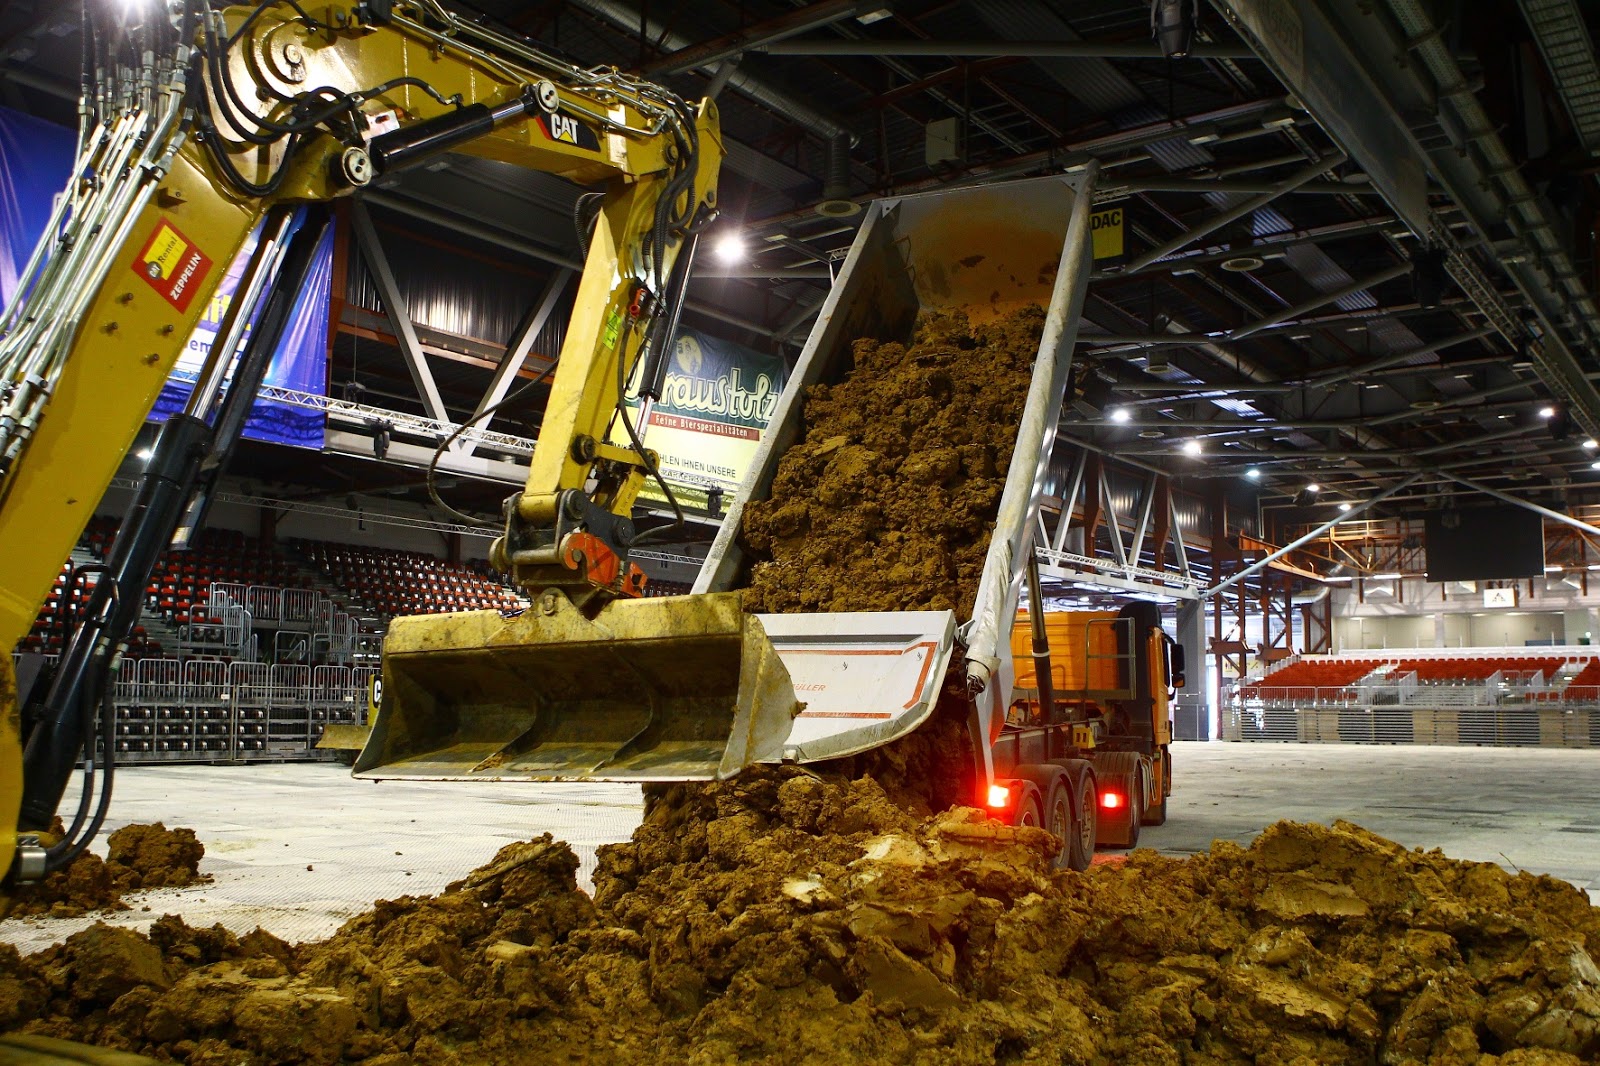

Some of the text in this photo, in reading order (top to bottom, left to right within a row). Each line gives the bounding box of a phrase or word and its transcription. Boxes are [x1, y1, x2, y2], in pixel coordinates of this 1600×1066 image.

[551, 113, 578, 144] CAT
[1091, 211, 1120, 230] DAC
[158, 236, 178, 263] Rental
[149, 264, 161, 278] CAT
[169, 252, 202, 300] ZEPPELIN
[655, 414, 748, 437] Feine Bierspezialitäten
[660, 454, 736, 478] HLEN IHNEN UNSERE
